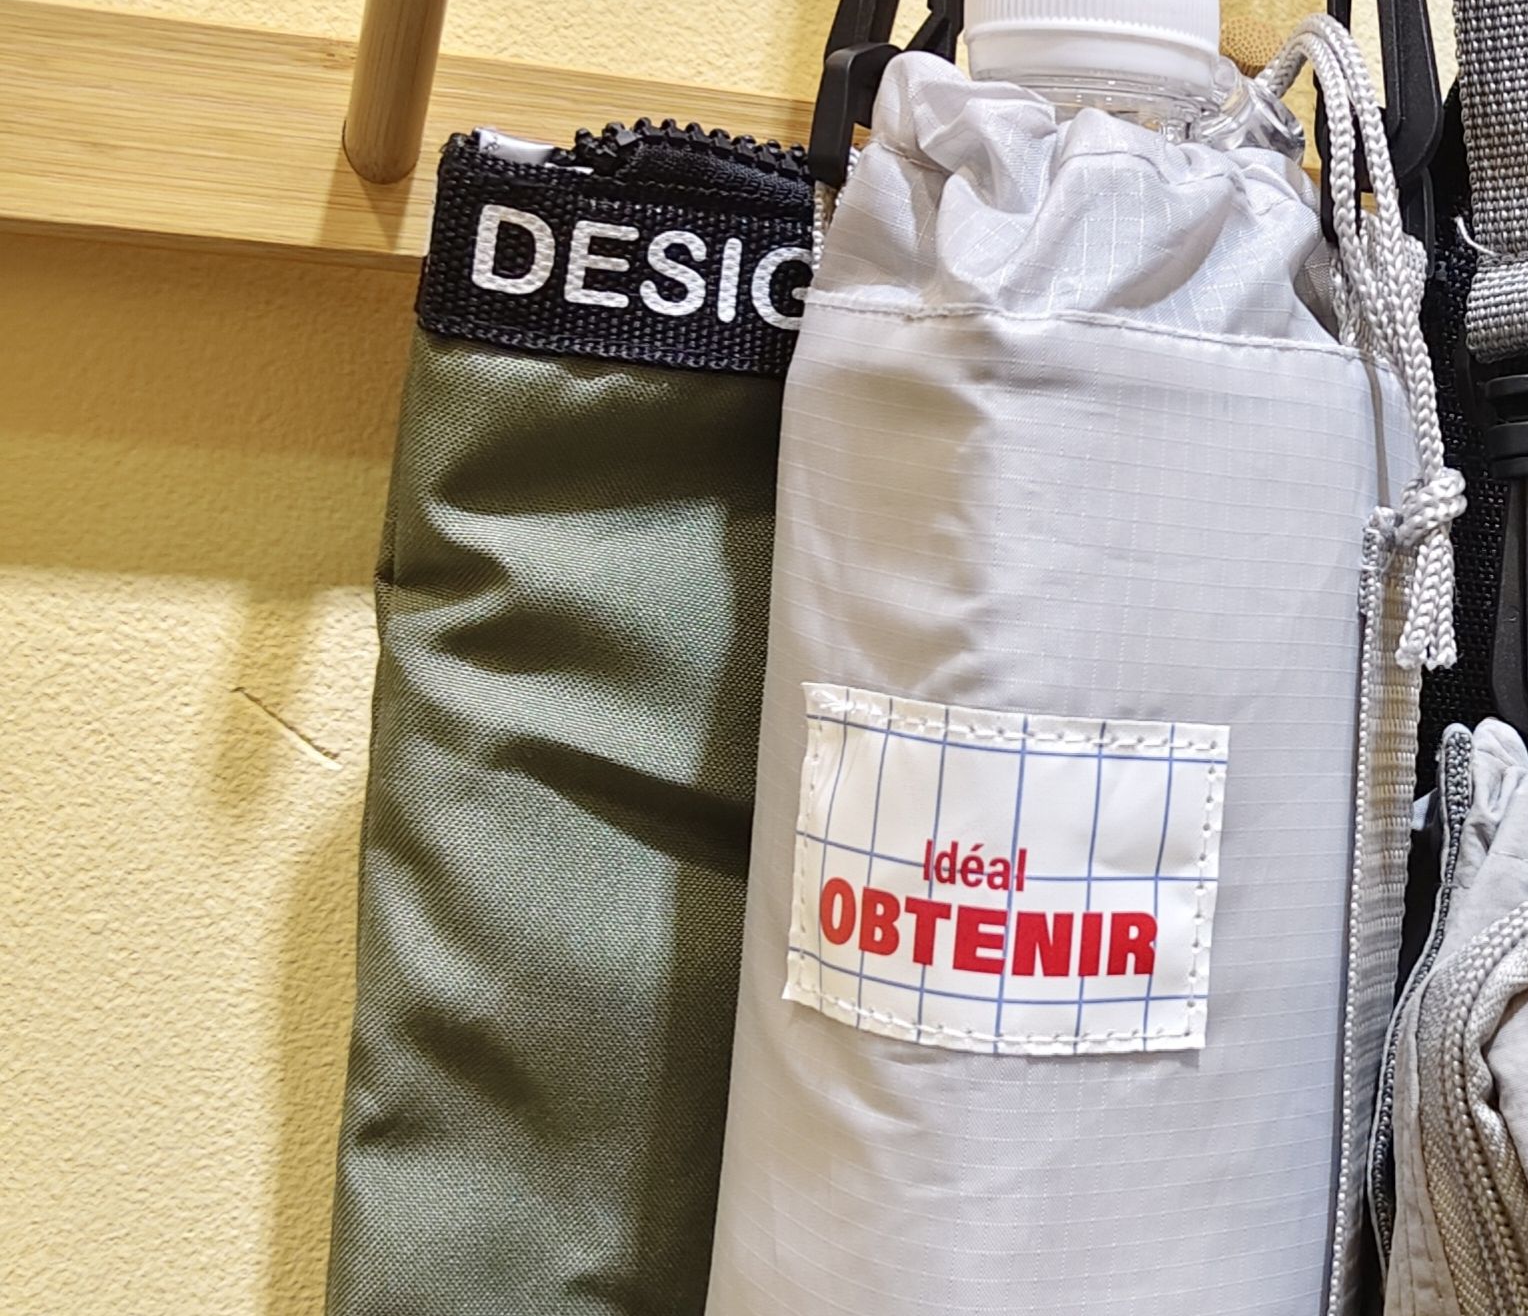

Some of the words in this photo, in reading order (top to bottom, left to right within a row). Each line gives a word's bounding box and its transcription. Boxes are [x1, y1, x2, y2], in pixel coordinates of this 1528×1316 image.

[470, 202, 814, 332] DESIG
[922, 837, 1029, 893] Idéal
[819, 876, 1159, 978] OBTENIR
